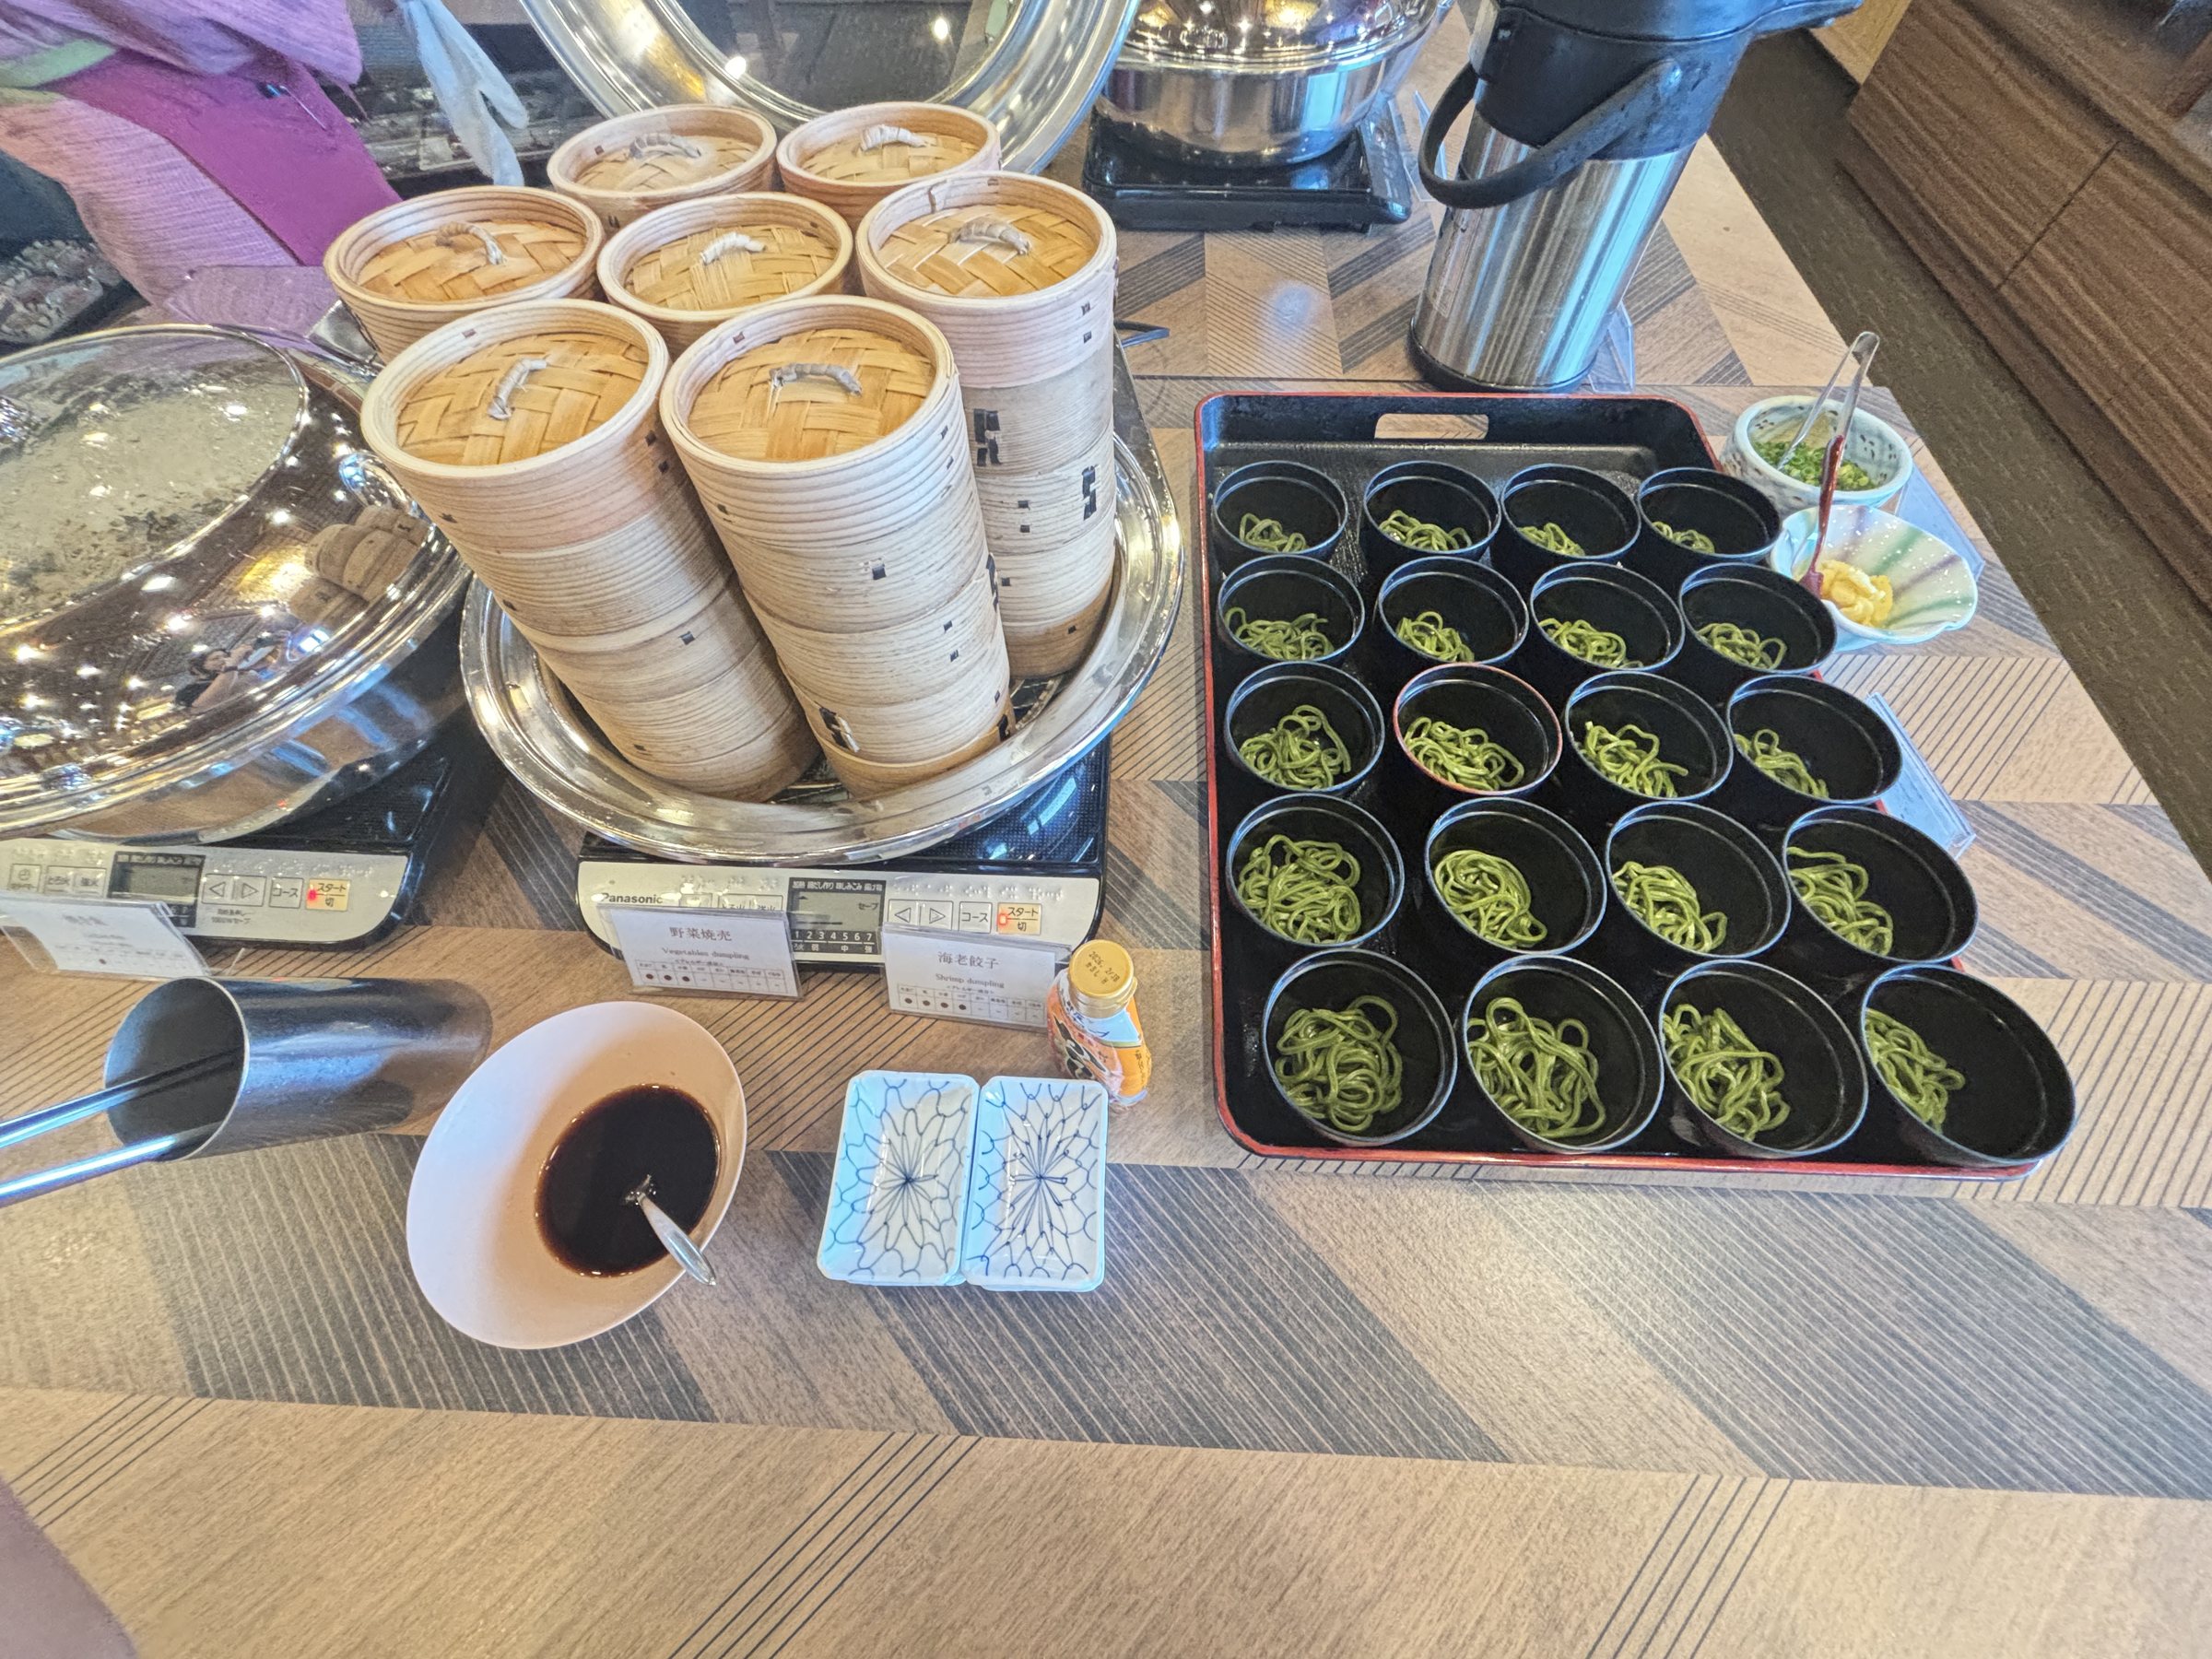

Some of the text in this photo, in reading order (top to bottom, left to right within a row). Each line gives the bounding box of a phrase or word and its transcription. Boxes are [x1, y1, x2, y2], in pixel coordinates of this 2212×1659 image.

[317, 882, 347, 893] スタート
[273, 888, 299, 899] コース
[601, 892, 663, 904] Panasonic
[324, 897, 335, 908] 切
[1007, 906, 1039, 917] スタート
[960, 912, 989, 923] コース
[1017, 922, 1028, 932] 切
[669, 926, 733, 941] 野菜焼売
[806, 931, 813, 940] 2
[818, 931, 825, 940] 3
[830, 932, 837, 940] 4
[842, 932, 849, 941] 5
[854, 933, 861, 941] 6
[865, 933, 873, 941] 7
[841, 945, 849, 953] 中
[937, 951, 1000, 970] 海老餃子
[935, 972, 1006, 989] Shrimp dumpling
